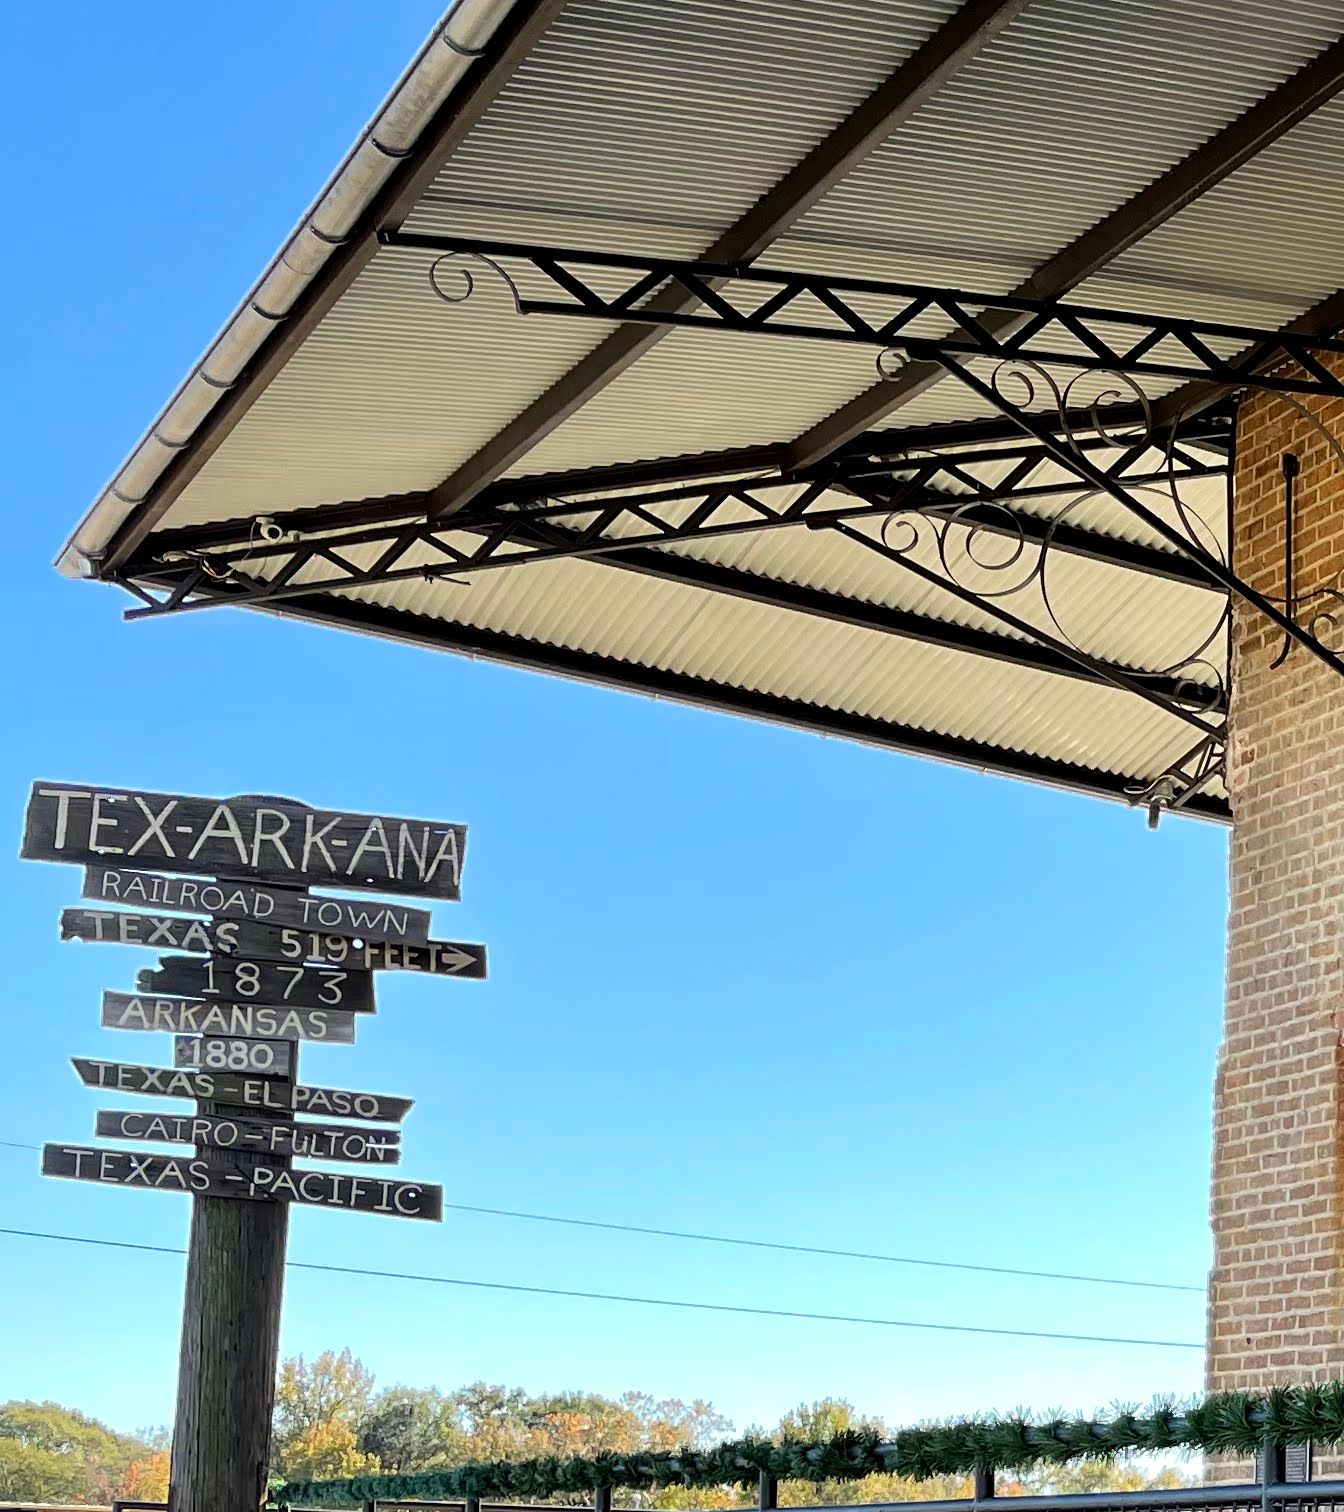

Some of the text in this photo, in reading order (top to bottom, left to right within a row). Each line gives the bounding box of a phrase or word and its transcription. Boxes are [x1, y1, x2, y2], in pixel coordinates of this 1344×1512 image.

[39, 788, 460, 887] TEX-ARK-ANA
[101, 870, 408, 935] RAILROAD TOWN
[83, 910, 443, 972] TEXAS 519 FEET
[201, 962, 347, 1005] 1873
[118, 997, 328, 1039] ARKANSAS
[186, 1038, 275, 1072] 1880
[292, 1085, 381, 1118] PASO
